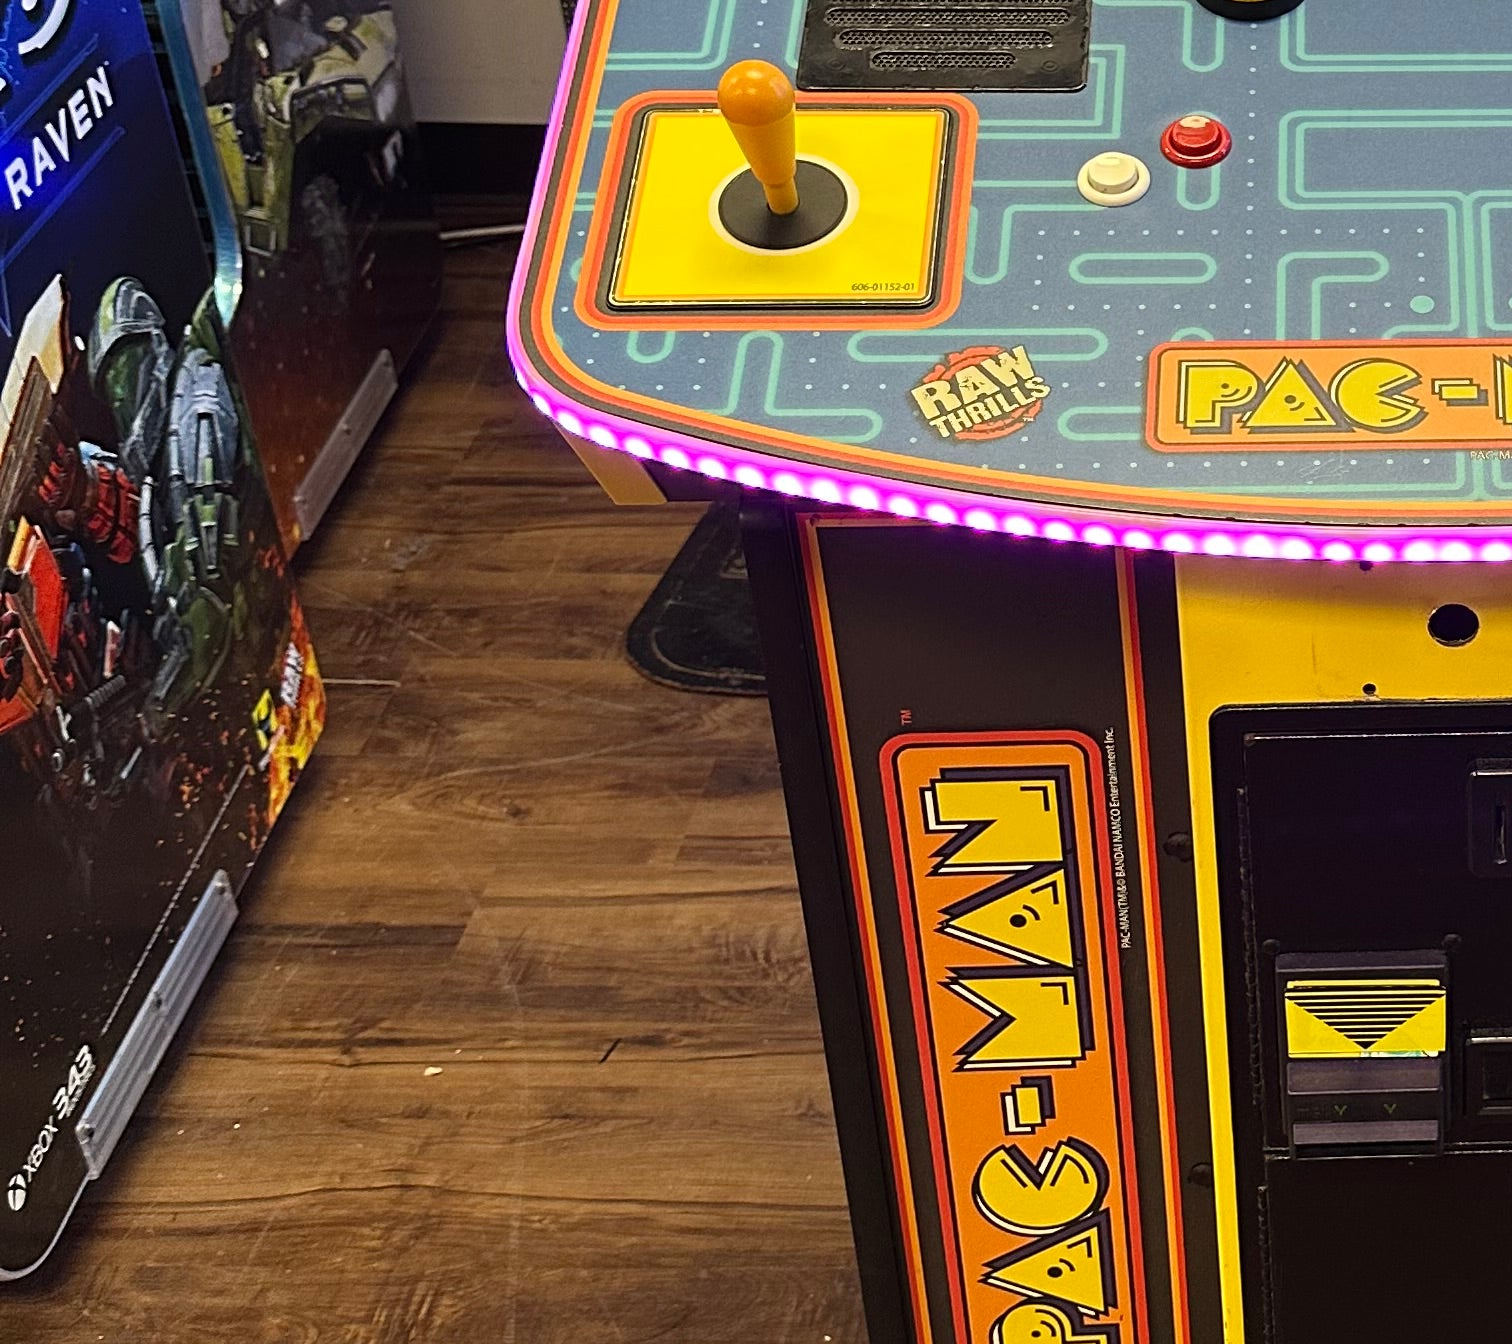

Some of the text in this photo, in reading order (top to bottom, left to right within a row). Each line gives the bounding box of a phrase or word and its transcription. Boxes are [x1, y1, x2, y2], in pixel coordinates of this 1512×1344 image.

[4, 65, 114, 211] RAVEN
[910, 345, 1036, 420] RAW
[928, 376, 1051, 439] THRILLS
[1105, 744, 1121, 808] Entertainment
[1110, 808, 1123, 843] NAMCO
[1113, 844, 1127, 877] BANDAI
[52, 1045, 92, 1120] 343
[22, 1115, 59, 1183] XBOX
